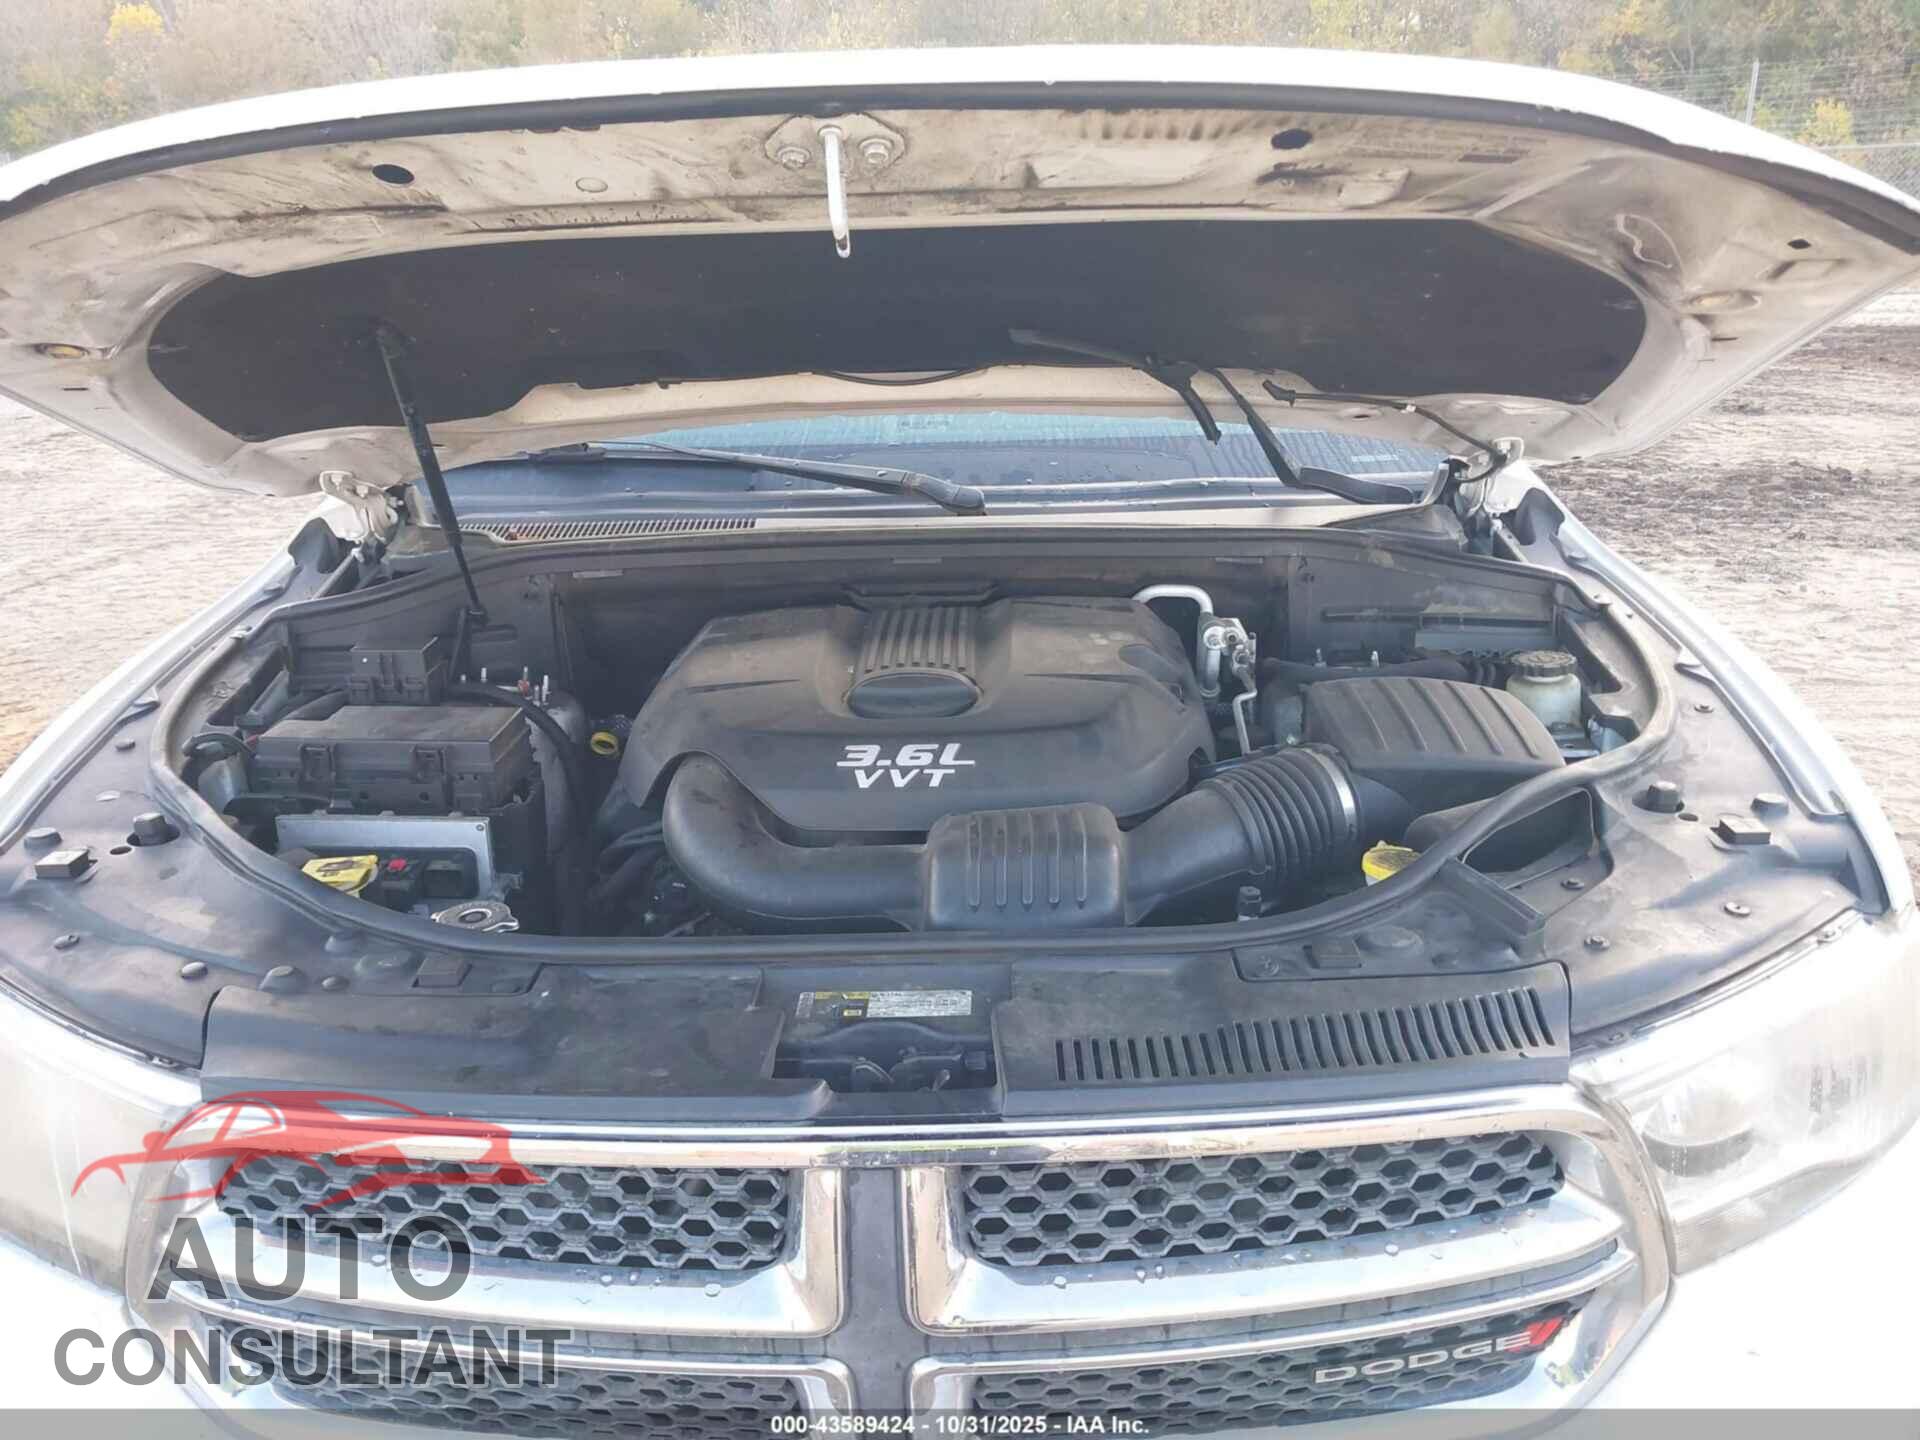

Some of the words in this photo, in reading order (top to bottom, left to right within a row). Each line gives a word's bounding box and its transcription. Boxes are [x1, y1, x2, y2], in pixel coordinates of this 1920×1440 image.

[836, 743, 975, 767] 3.6L
[854, 769, 955, 788] VVT
[1314, 1331, 1532, 1384] DODGE
